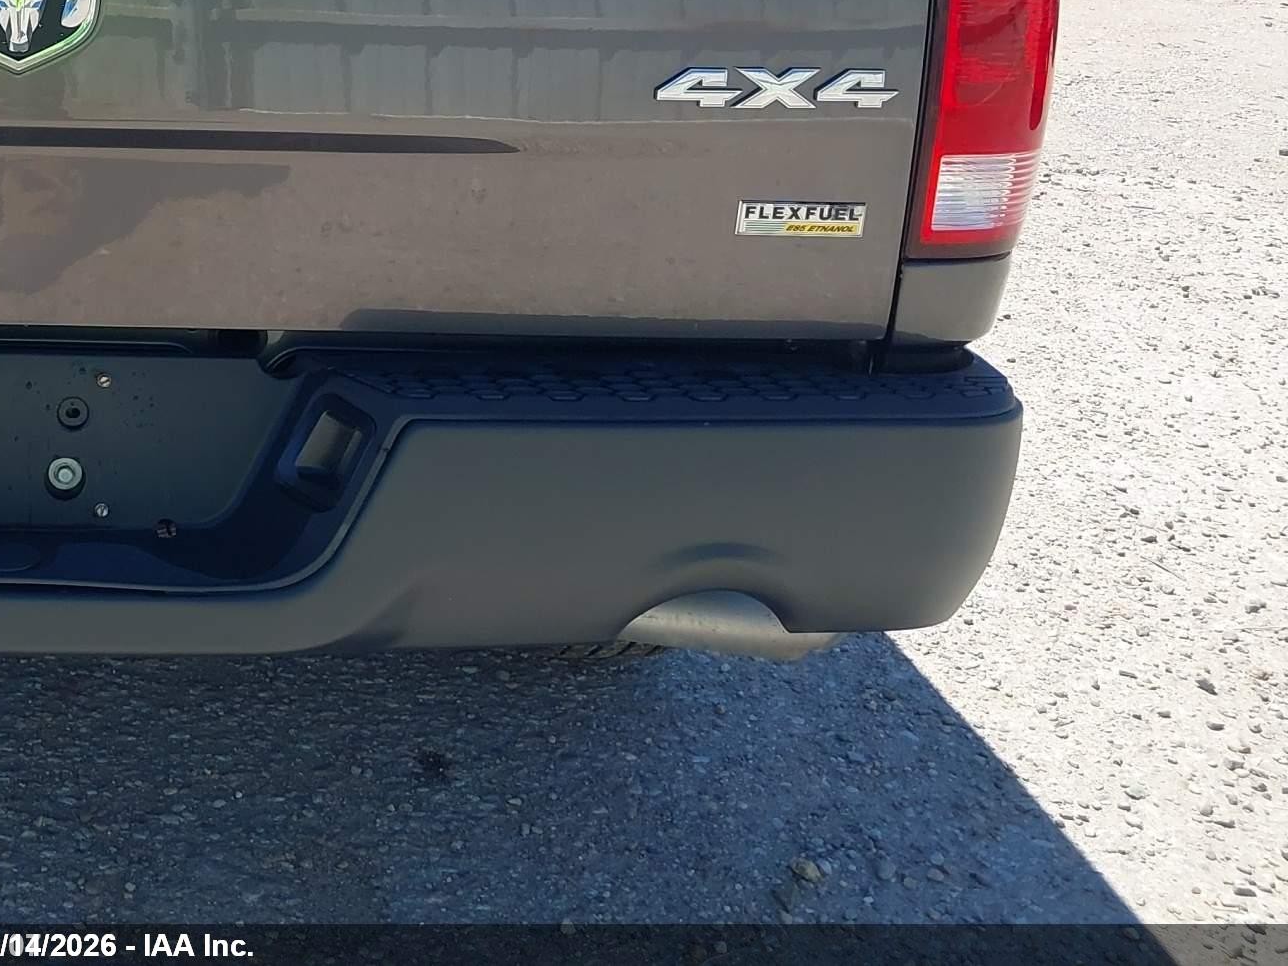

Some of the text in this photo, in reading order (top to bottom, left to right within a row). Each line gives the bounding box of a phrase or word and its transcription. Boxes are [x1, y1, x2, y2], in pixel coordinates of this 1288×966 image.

[744, 205, 860, 221] FLEXFUEL
[786, 224, 855, 233] E85 ETHANOL
